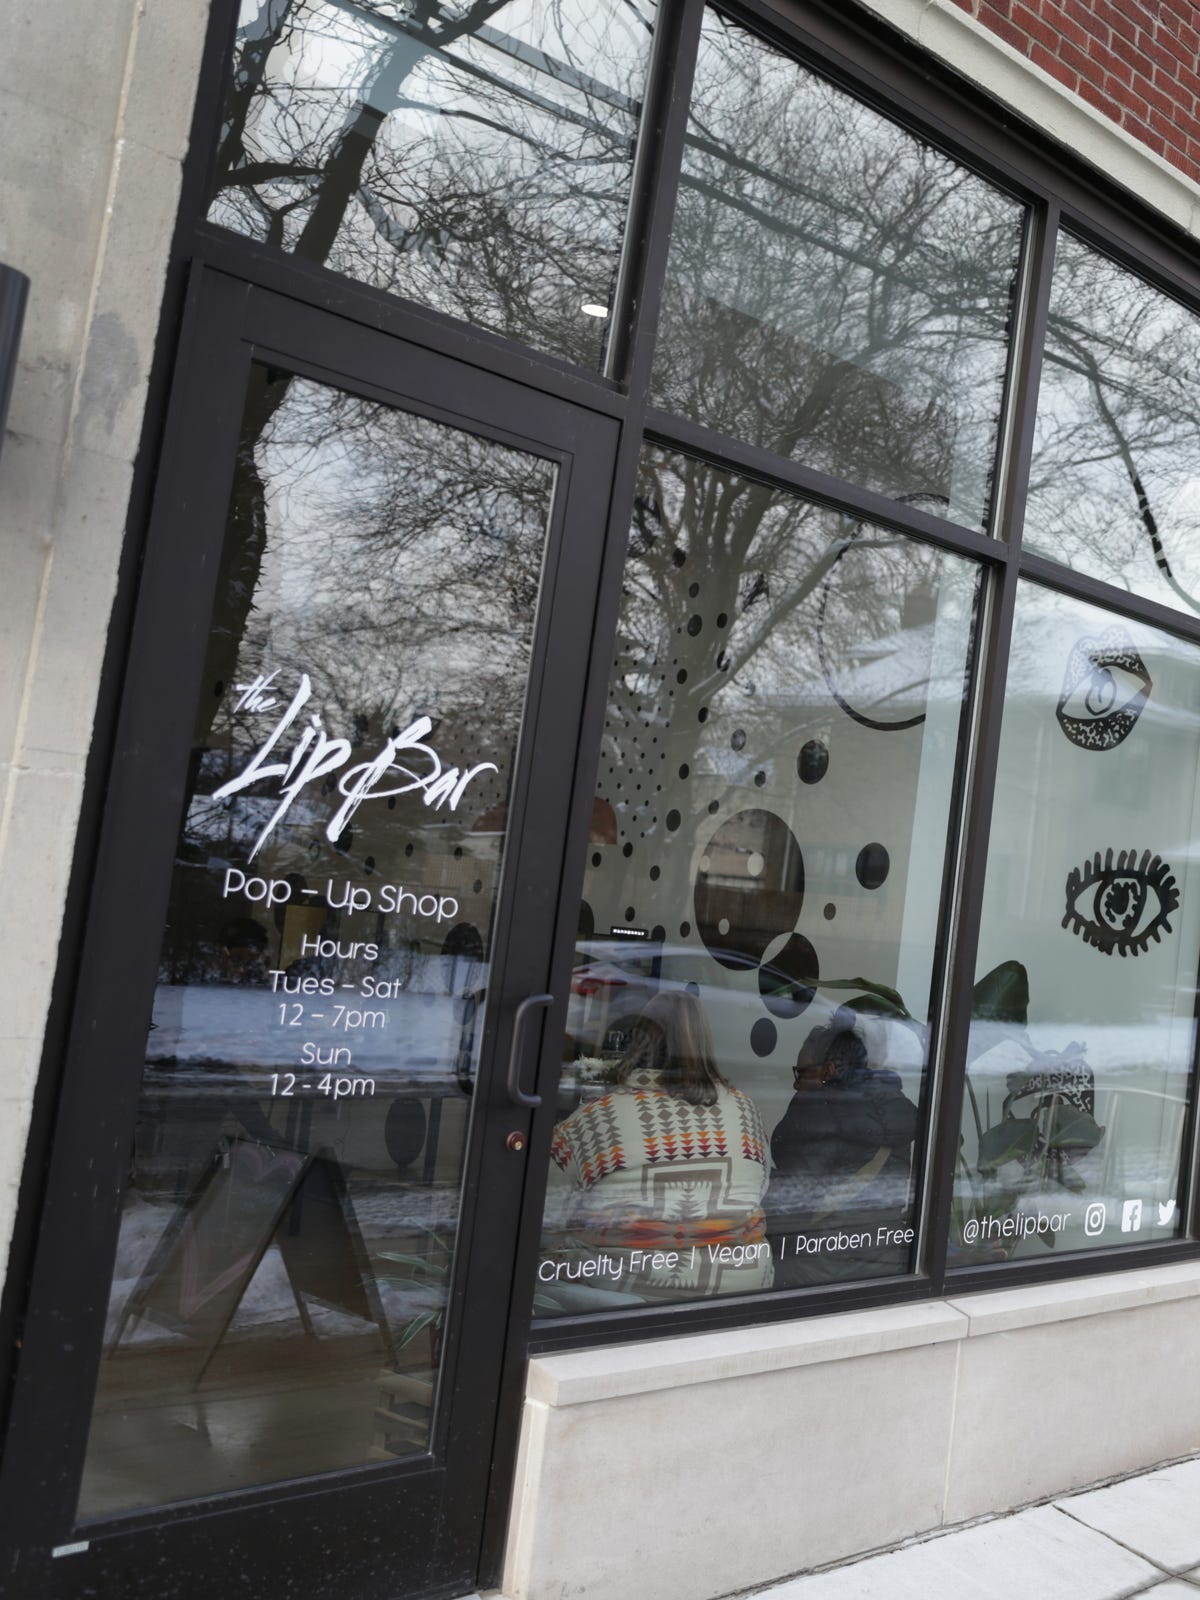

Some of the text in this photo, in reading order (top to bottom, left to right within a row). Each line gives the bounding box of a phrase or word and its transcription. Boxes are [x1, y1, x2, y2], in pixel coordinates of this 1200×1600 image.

[233, 668, 282, 713] the
[212, 673, 499, 865] Lip Bar
[223, 868, 291, 909] Pop
[326, 879, 371, 916] Up
[378, 885, 459, 923] Shop
[301, 934, 379, 961] Hours
[268, 970, 335, 996] Tues
[360, 976, 402, 999] Sat
[278, 1003, 304, 1027] 12
[332, 1005, 386, 1033] 7pm
[300, 1043, 352, 1065] Sun
[270, 1074, 295, 1096] 12
[317, 1074, 376, 1100] 4pm
[963, 1212, 1071, 1243] @thelipbar
[537, 1254, 624, 1281] Cruelty
[629, 1248, 678, 1271] Free
[708, 1241, 771, 1268] Vegan
[795, 1232, 872, 1256] Paraben
[876, 1226, 915, 1247] Free
